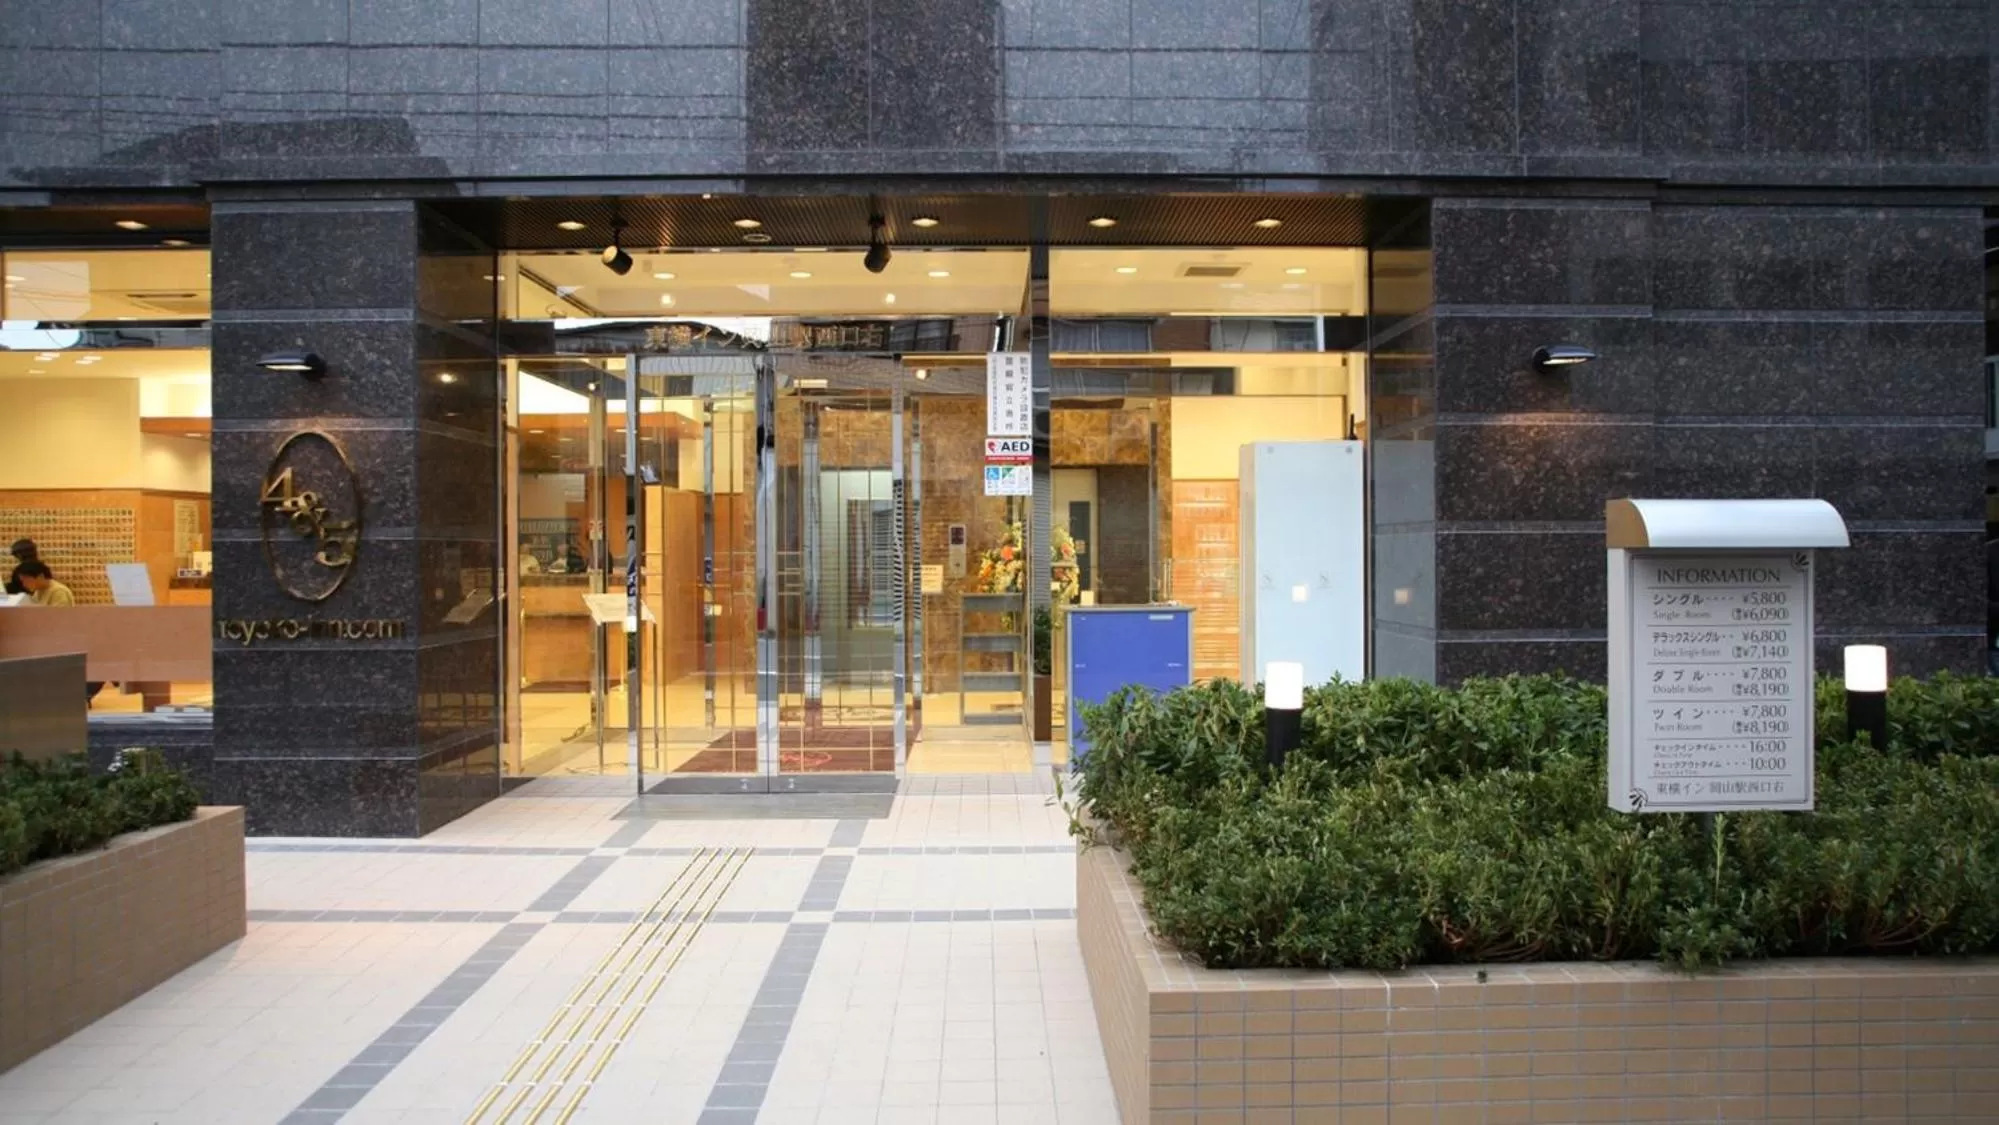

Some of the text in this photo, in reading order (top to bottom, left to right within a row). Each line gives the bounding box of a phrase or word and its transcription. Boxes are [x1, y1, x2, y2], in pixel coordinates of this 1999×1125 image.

[1001, 441, 1030, 452] AED
[1657, 568, 1781, 583] INFORMATION
[1653, 592, 1786, 605] シングル ¥5,800
[1652, 630, 1787, 643] デラックスシングル ¥6,800
[1653, 667, 1787, 682] ダブル ¥7,800
[1653, 684, 1685, 694] Double
[1688, 684, 1713, 693] Room
[1653, 705, 1787, 720] ツイン ¥7,800
[1677, 723, 1702, 731] Room
[1750, 740, 1786, 753] 16:00
[1750, 757, 1786, 770] 10:00
[1657, 781, 1704, 795] 東横イン
